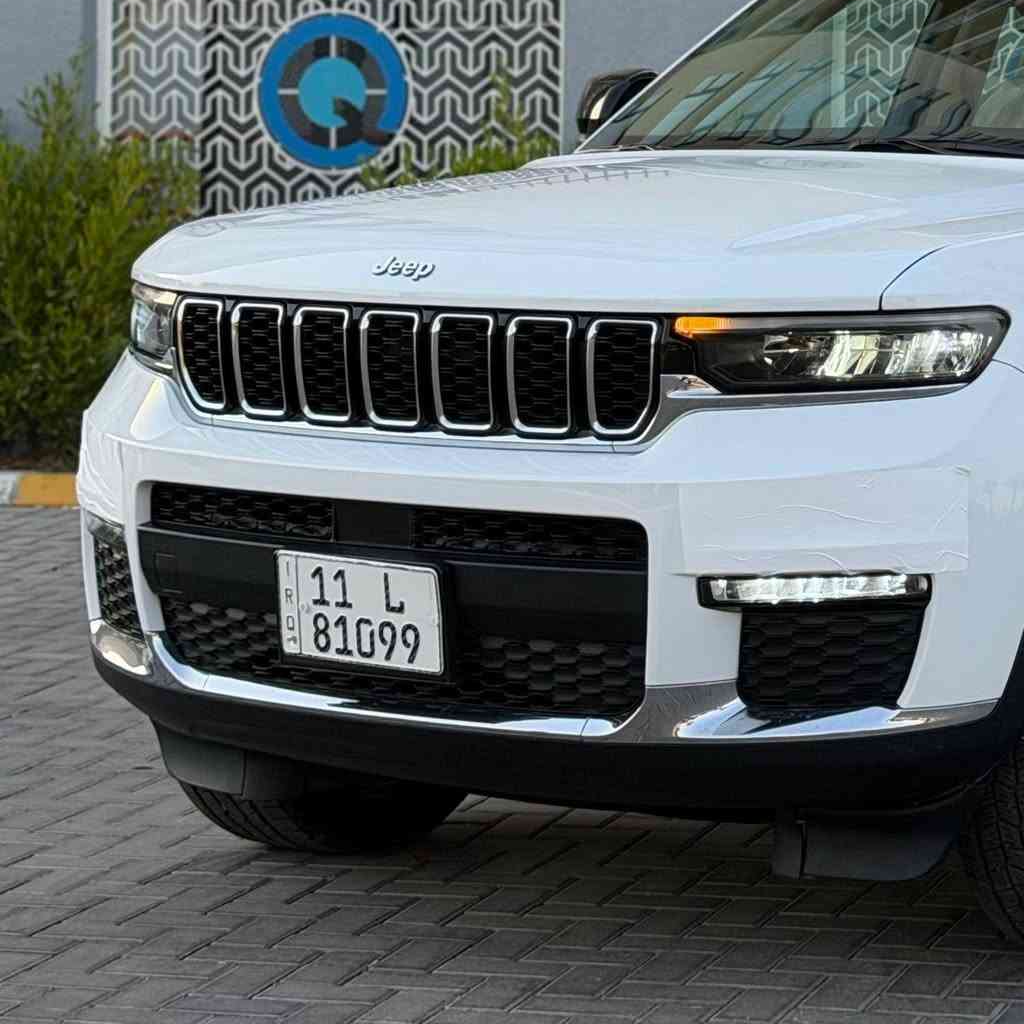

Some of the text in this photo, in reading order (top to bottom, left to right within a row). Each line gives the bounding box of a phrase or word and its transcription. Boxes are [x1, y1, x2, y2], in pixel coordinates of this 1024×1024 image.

[371, 255, 436, 282] Jeep
[311, 566, 405, 615] 11 L
[312, 612, 421, 665] 81099
